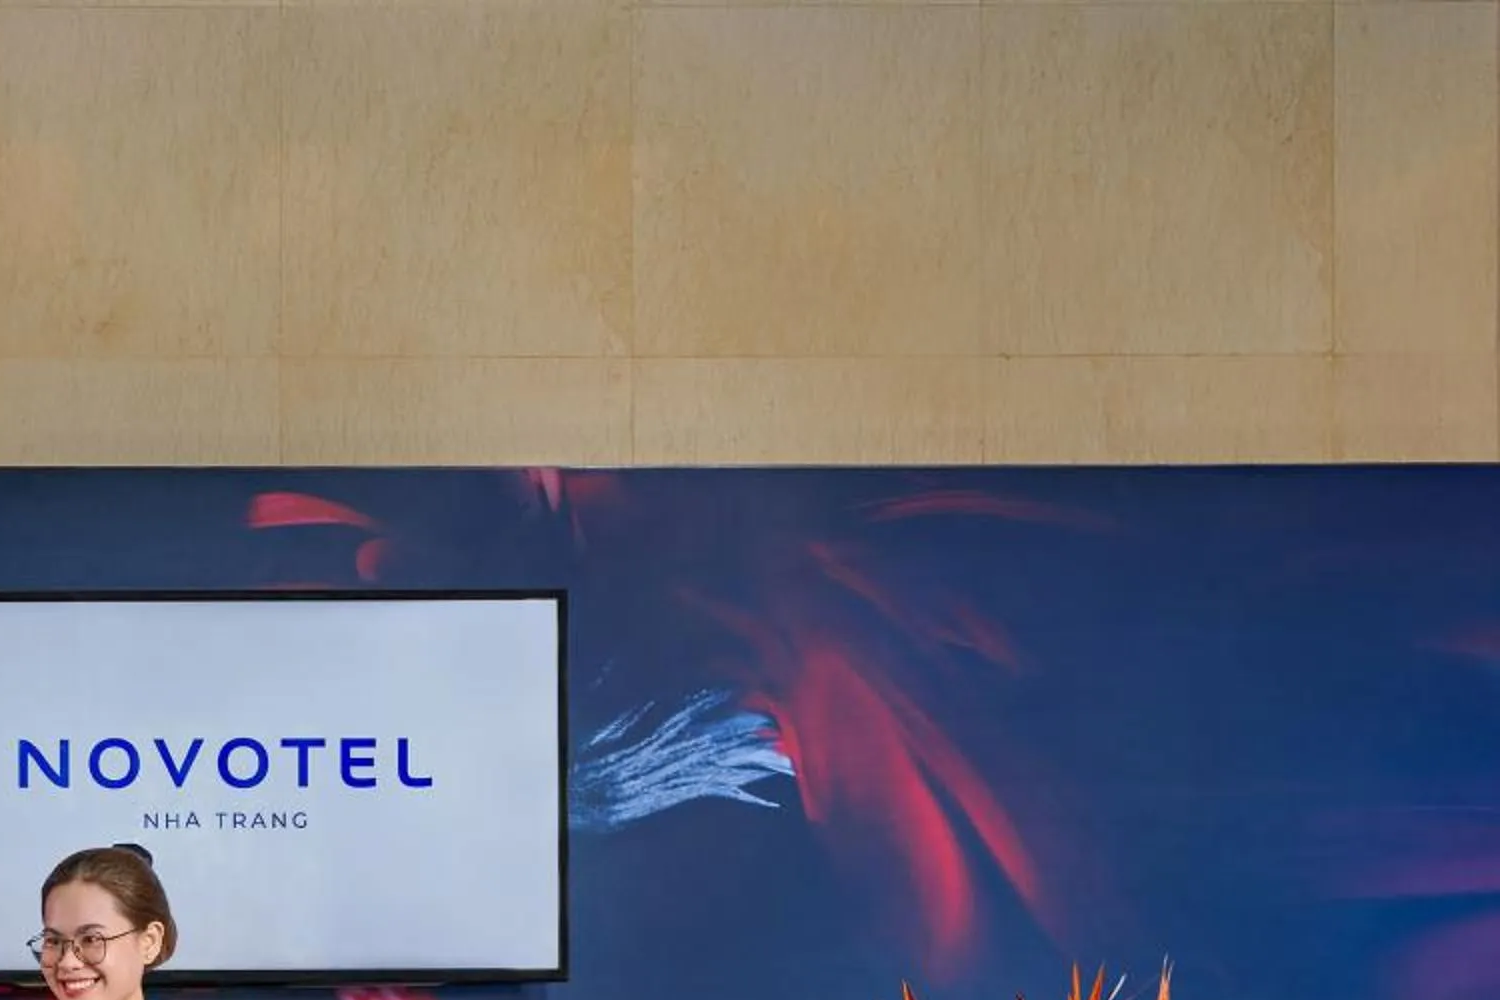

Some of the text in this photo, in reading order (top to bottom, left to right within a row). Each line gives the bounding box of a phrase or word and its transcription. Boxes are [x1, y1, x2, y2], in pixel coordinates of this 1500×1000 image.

[17, 737, 433, 789] NOVOTEL
[143, 811, 308, 830] NHA TRANG
